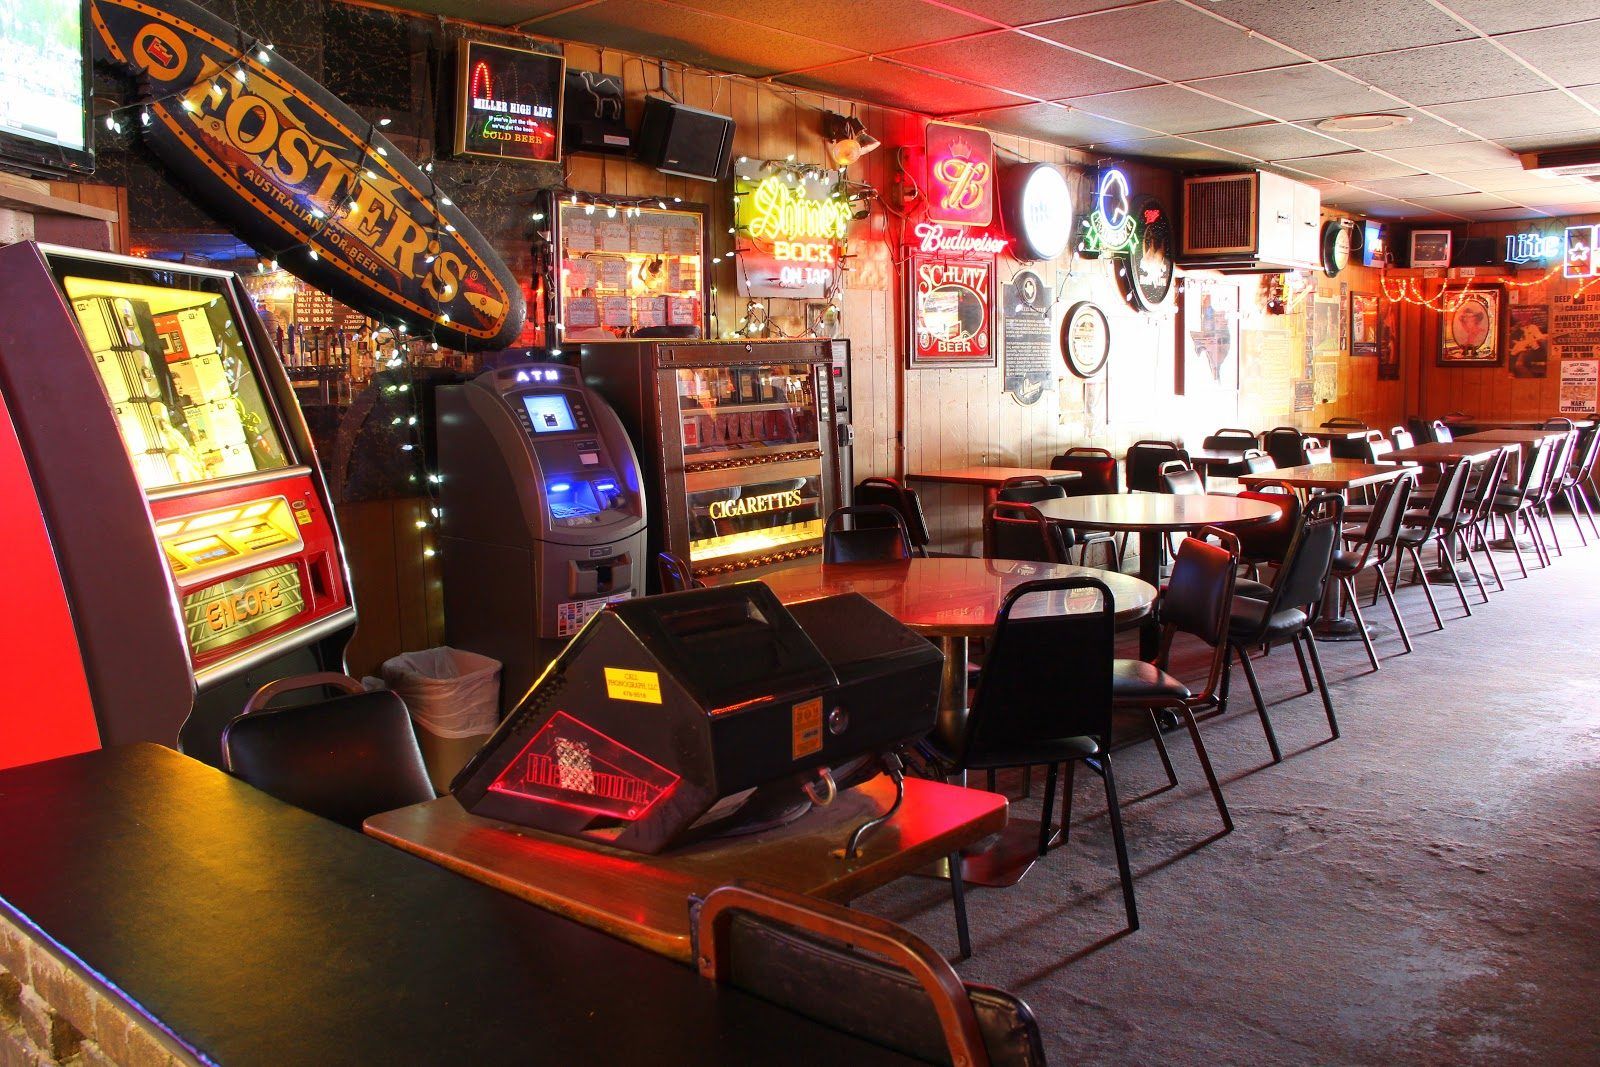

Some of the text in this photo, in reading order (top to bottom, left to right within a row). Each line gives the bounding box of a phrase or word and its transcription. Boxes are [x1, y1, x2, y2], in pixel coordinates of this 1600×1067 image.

[474, 98, 552, 118] MILLER HIGH LIFE
[482, 131, 542, 144] COLD BEER
[181, 53, 469, 304] FOSTER'S
[244, 169, 323, 232] AUSTRALIAN
[323, 227, 347, 252] FOR
[749, 176, 852, 240] Shiner
[774, 241, 834, 264] BOCK
[914, 223, 1008, 253] Budweiser
[1504, 233, 1560, 265] Lite
[781, 266, 831, 284] ON TAP
[918, 263, 988, 302] SCHLITZ
[1554, 293, 1600, 303] DEEP EDD
[937, 340, 972, 354] BEER
[516, 369, 559, 382] ATM
[709, 489, 802, 519] CIGARETTES
[205, 580, 283, 632] ENCORE
